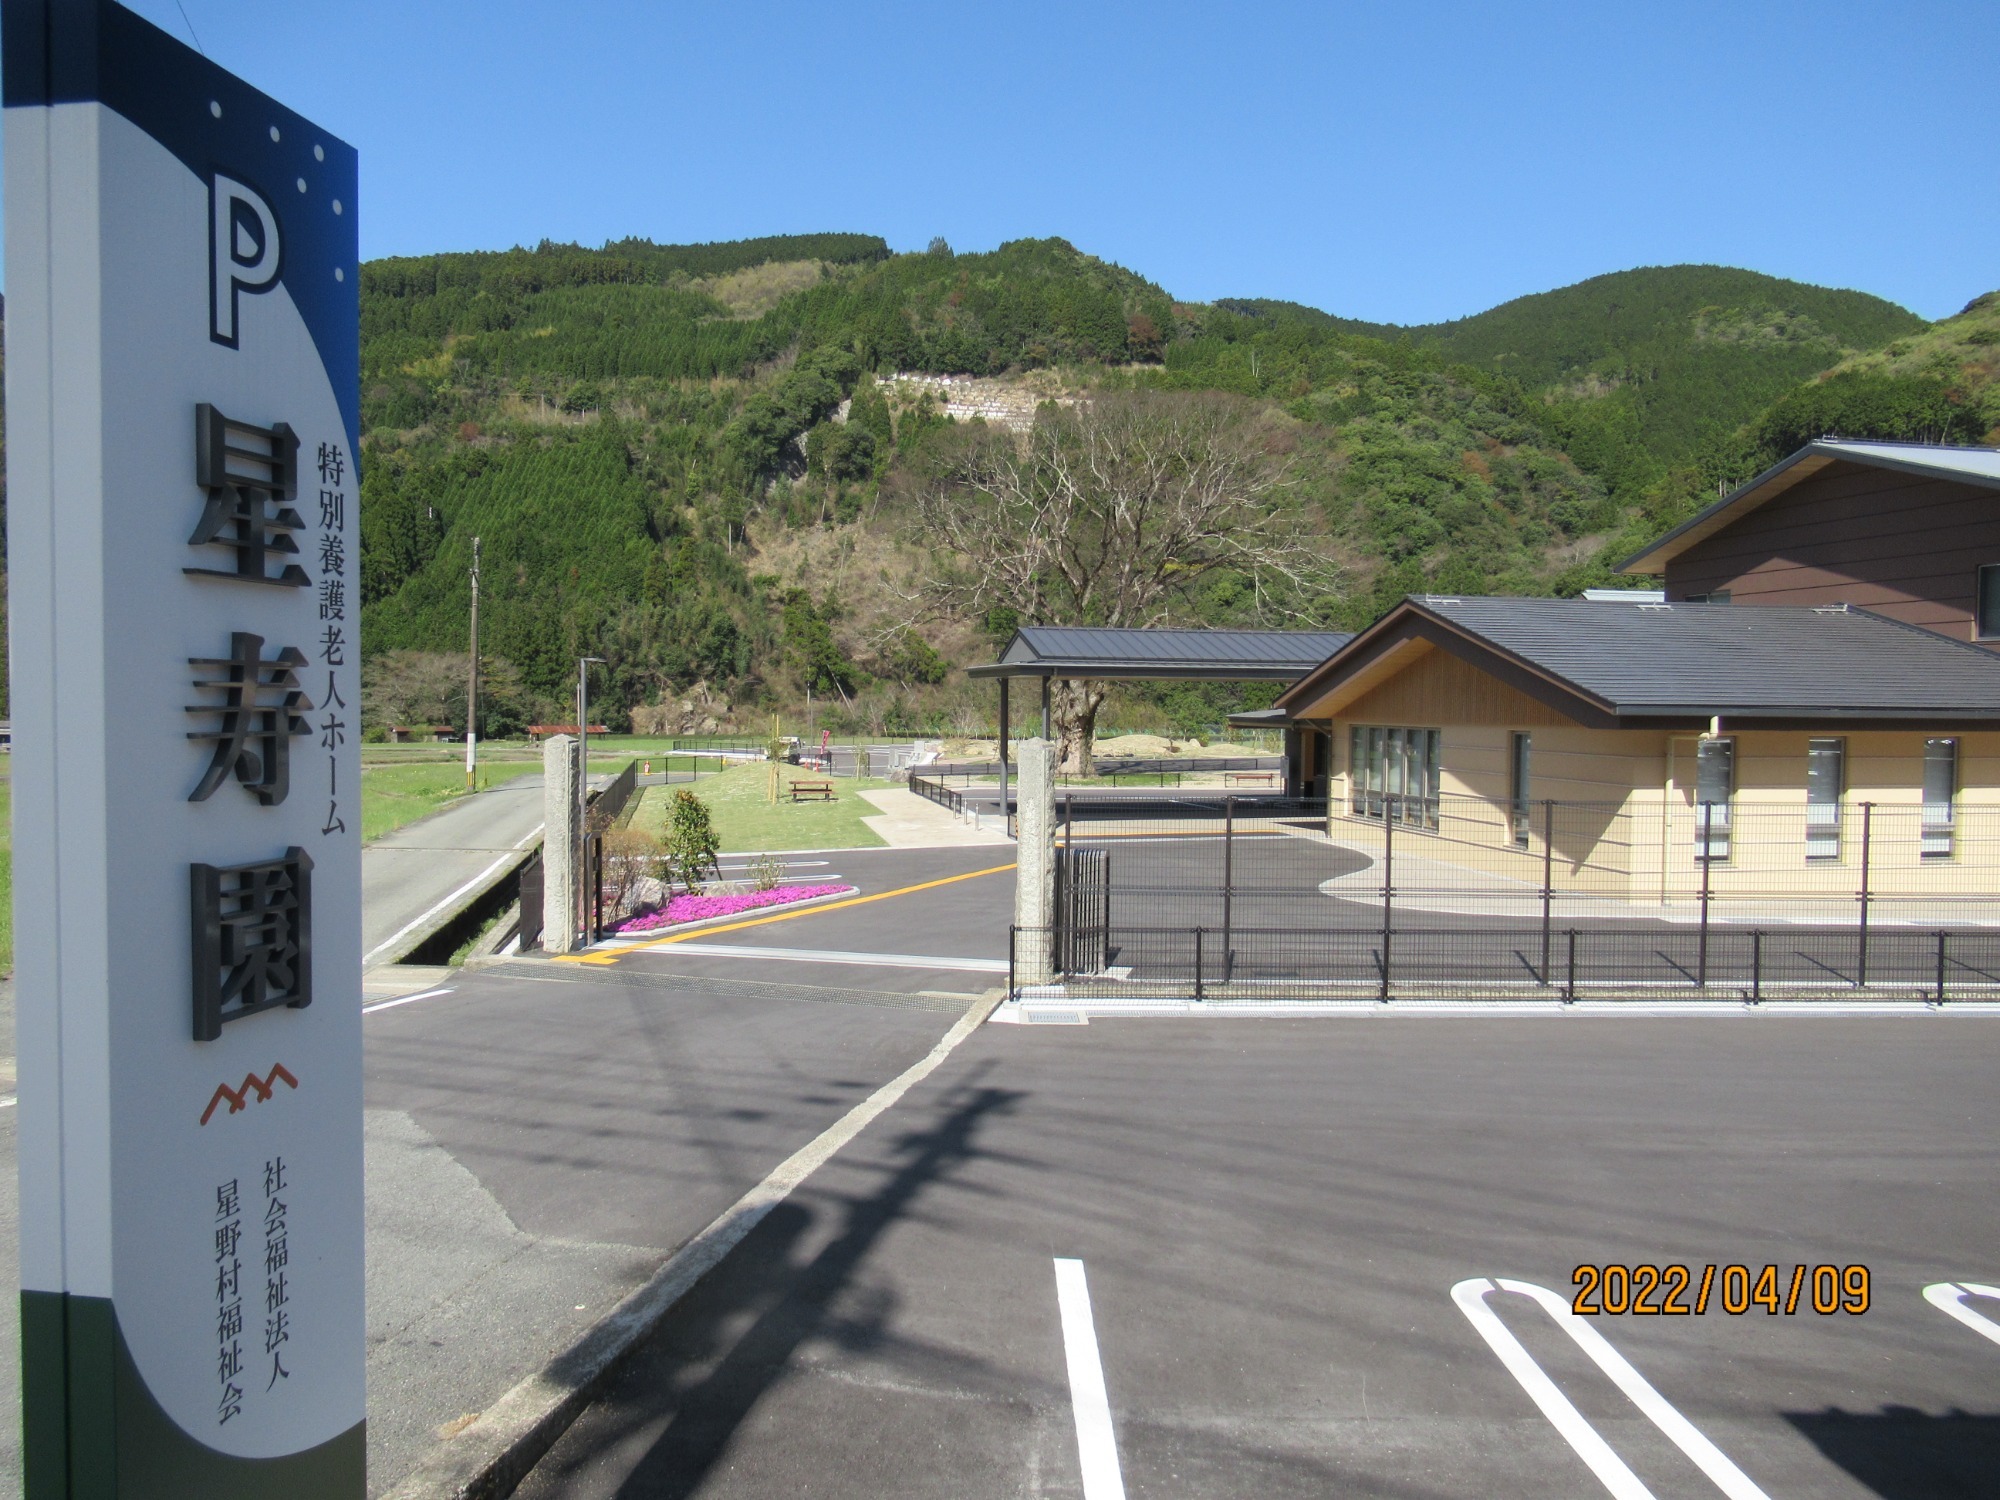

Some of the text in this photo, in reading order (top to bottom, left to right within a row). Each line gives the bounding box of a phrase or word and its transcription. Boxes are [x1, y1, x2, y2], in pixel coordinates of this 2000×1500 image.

[208, 165, 286, 351] P
[182, 403, 313, 1041] 星寿園
[316, 441, 347, 836] 特別養護老人ホーム
[214, 1178, 244, 1426] 星野村福祉会
[263, 1156, 290, 1393] 社会福祉法人
